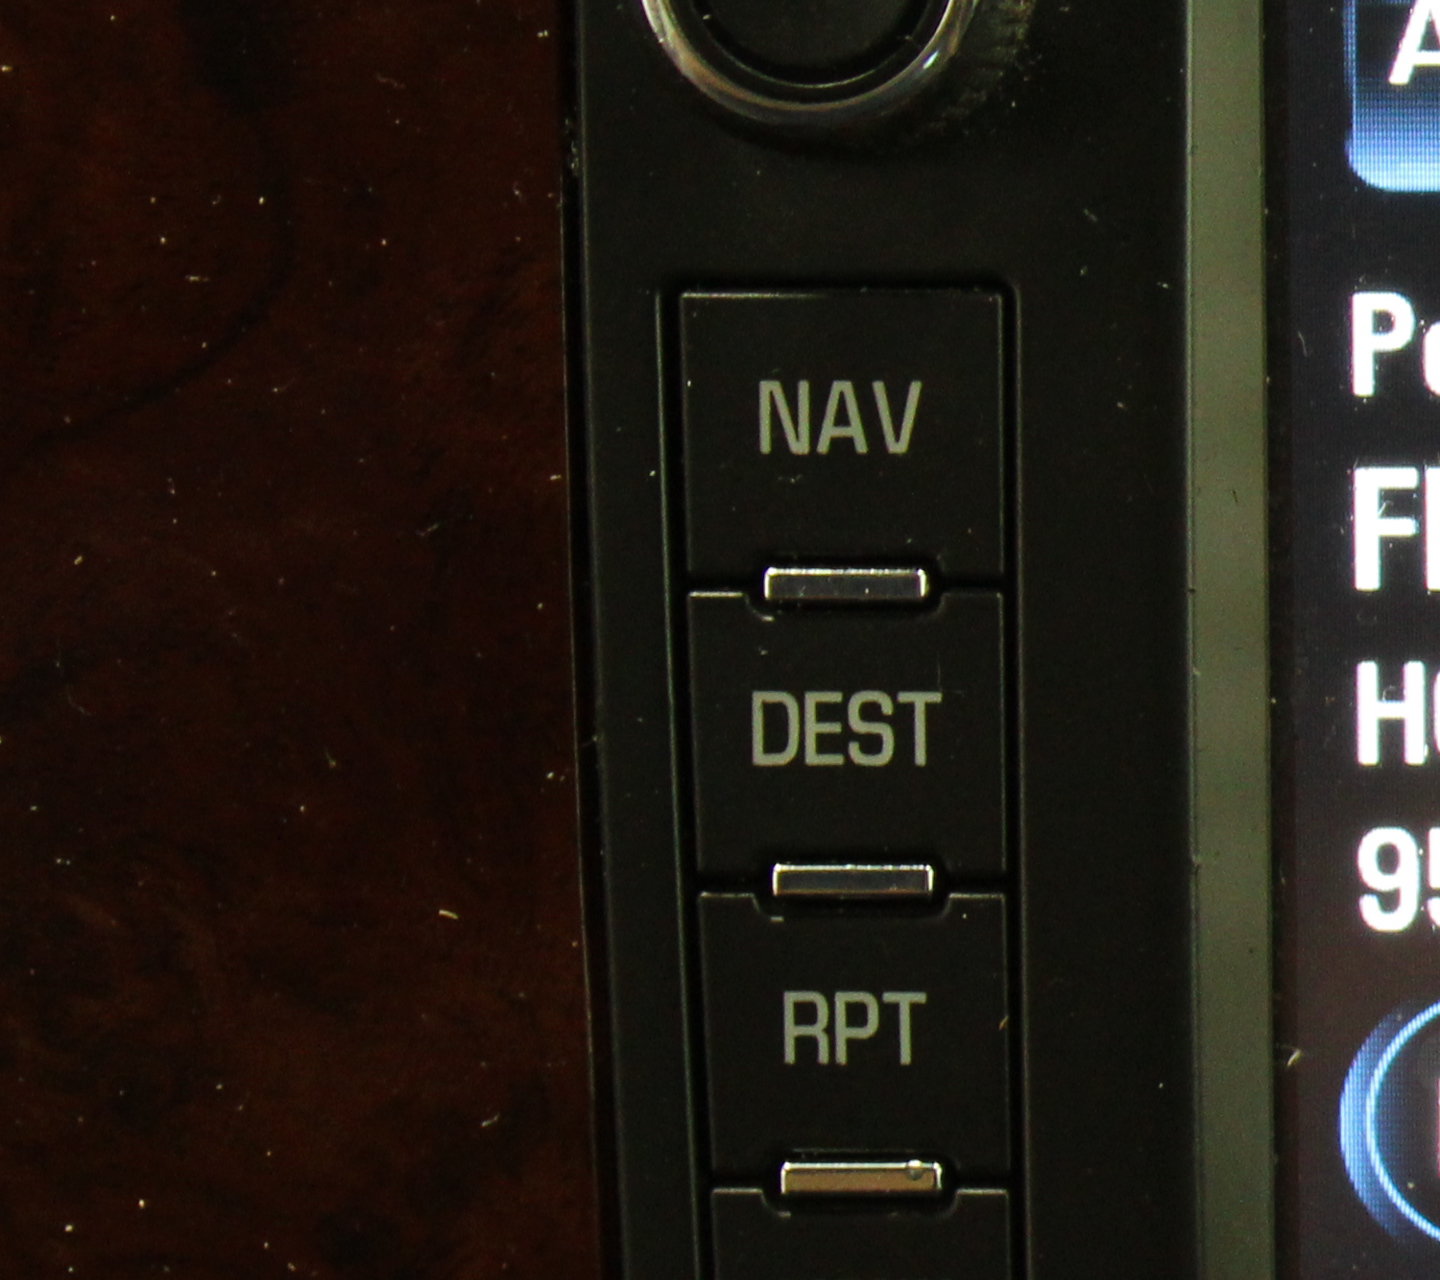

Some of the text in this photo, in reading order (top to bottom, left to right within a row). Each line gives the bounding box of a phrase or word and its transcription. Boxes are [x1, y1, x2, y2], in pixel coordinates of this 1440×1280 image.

[759, 379, 922, 456] NAV
[751, 692, 941, 769] DEST
[783, 990, 927, 1068] RPT
